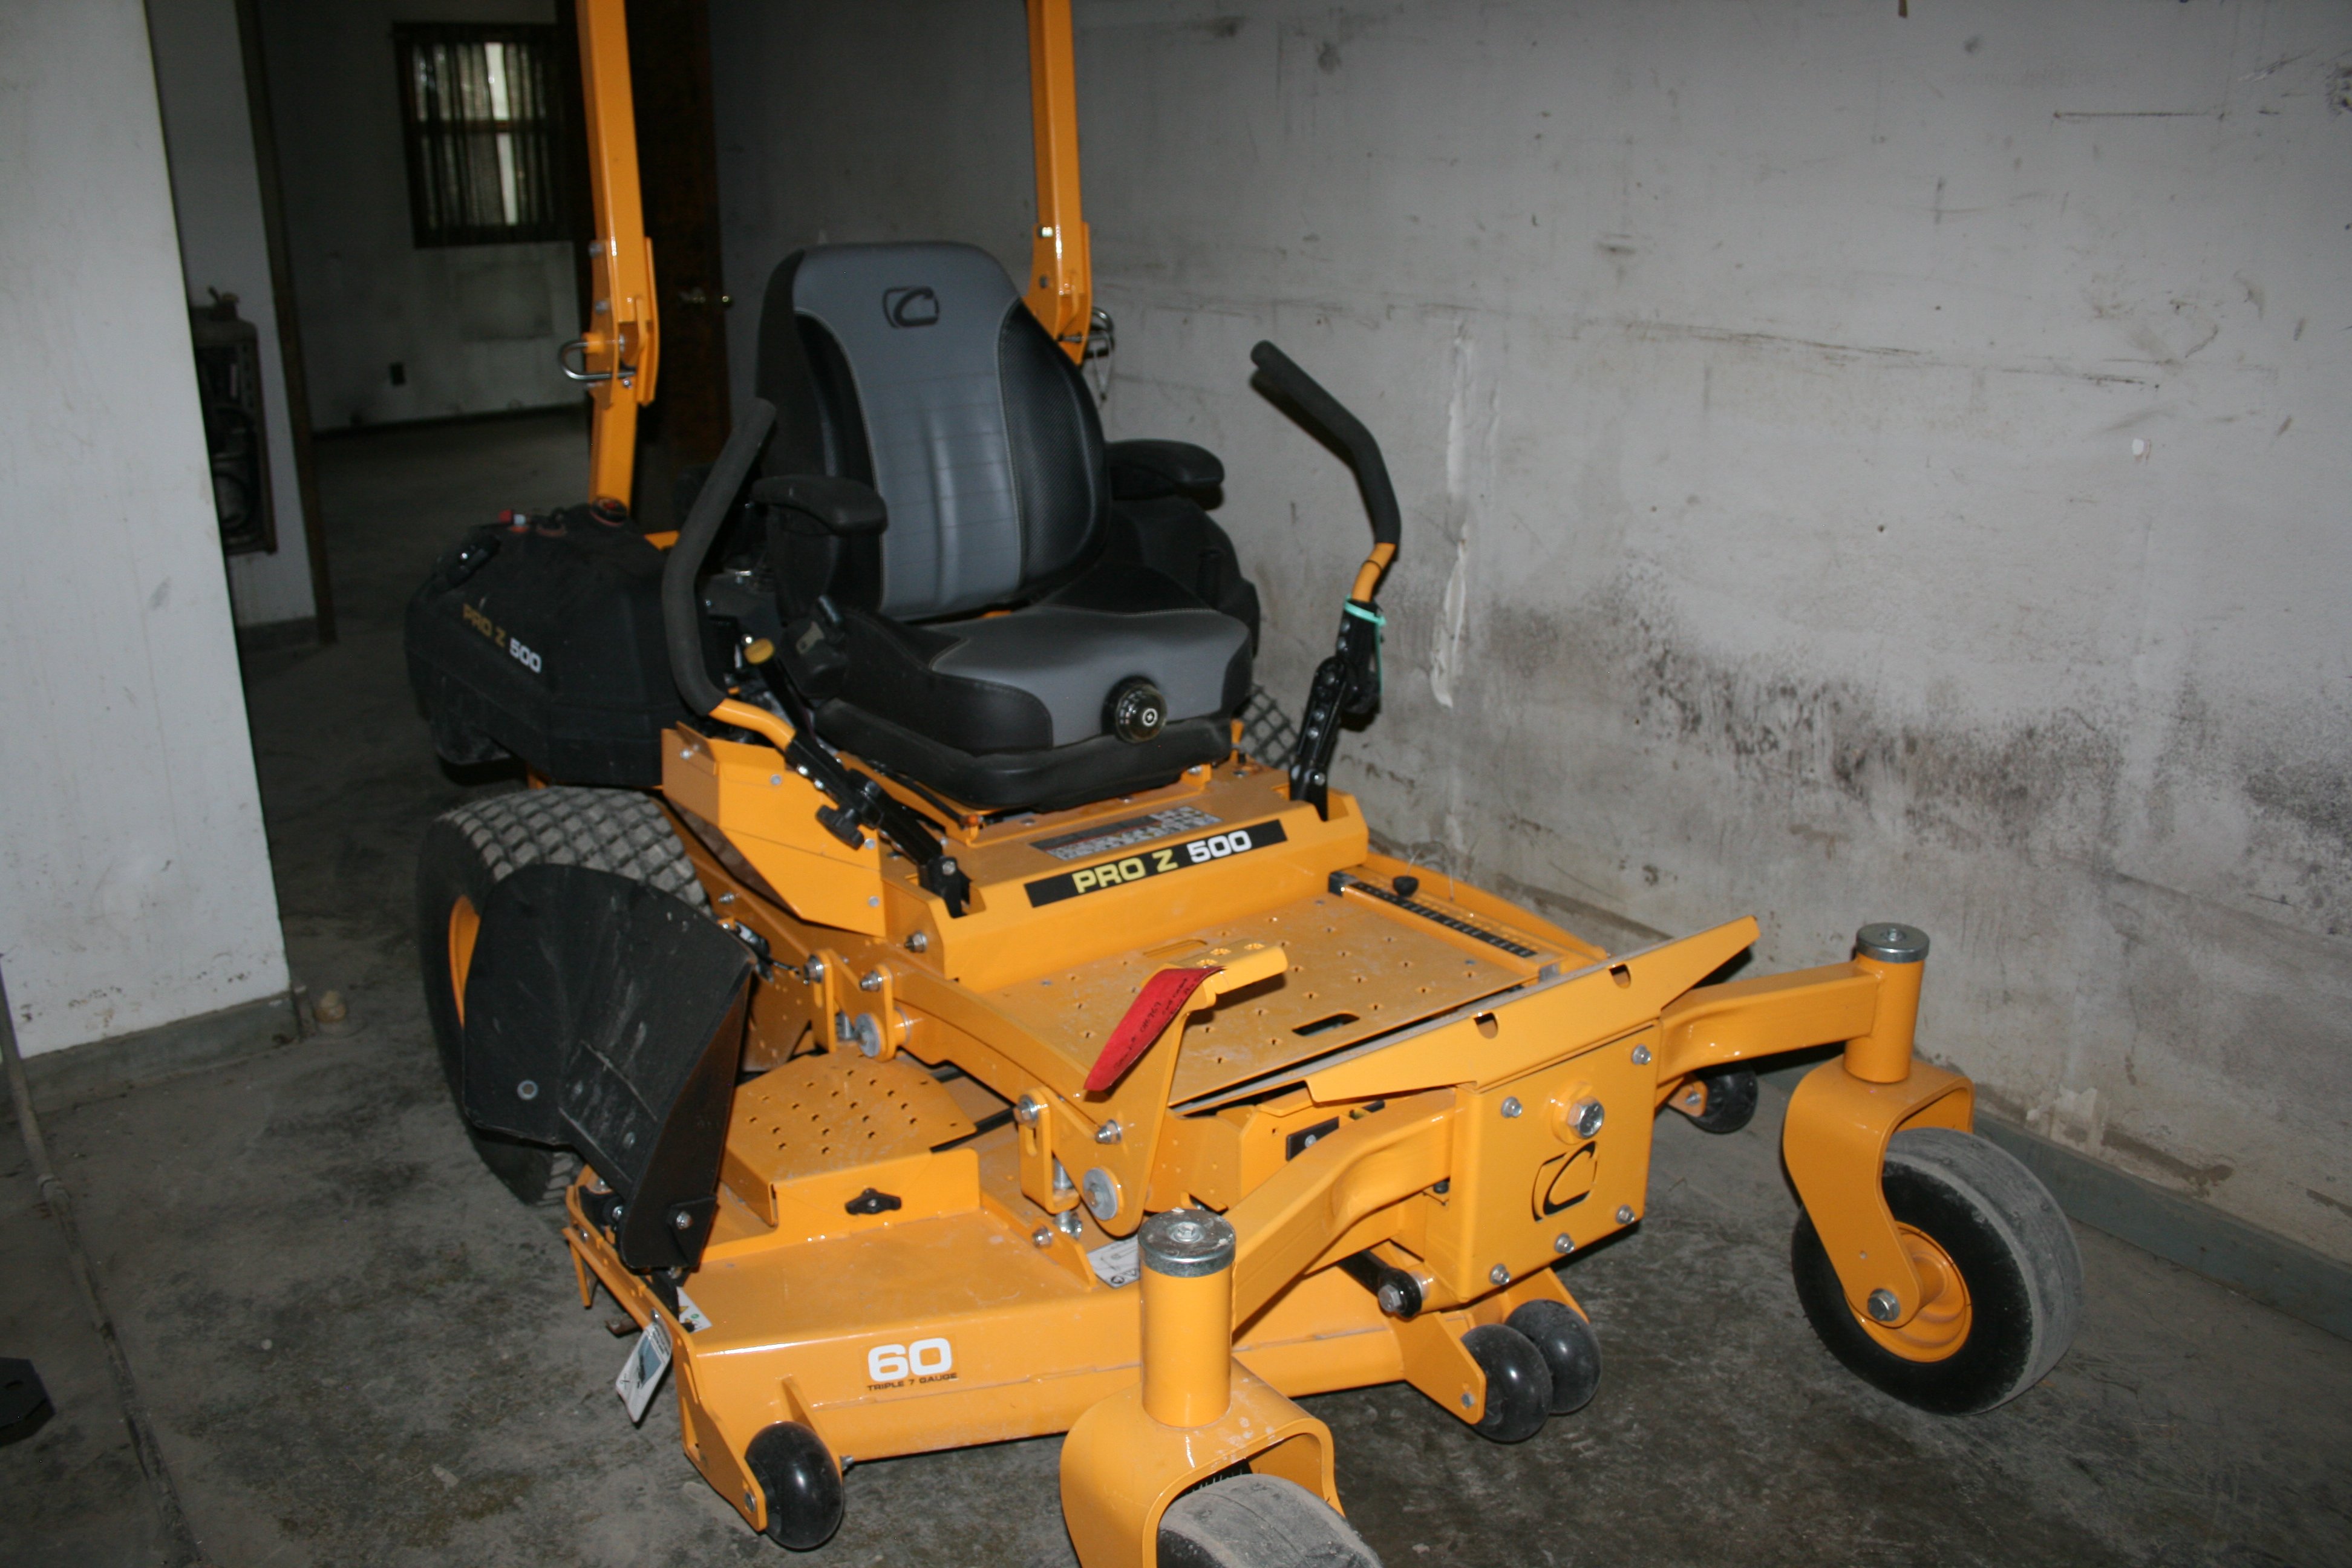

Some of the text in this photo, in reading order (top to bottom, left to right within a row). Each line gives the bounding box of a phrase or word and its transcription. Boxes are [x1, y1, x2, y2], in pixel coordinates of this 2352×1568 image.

[463, 603, 541, 673] PRO Z 500
[1071, 857, 1146, 893] PRO
[1152, 848, 1178, 873] Z
[1186, 830, 1253, 863] 500
[867, 1338, 953, 1382] 60
[867, 1380, 904, 1391] TRIPLE
[919, 1373, 958, 1383] GAUGE
